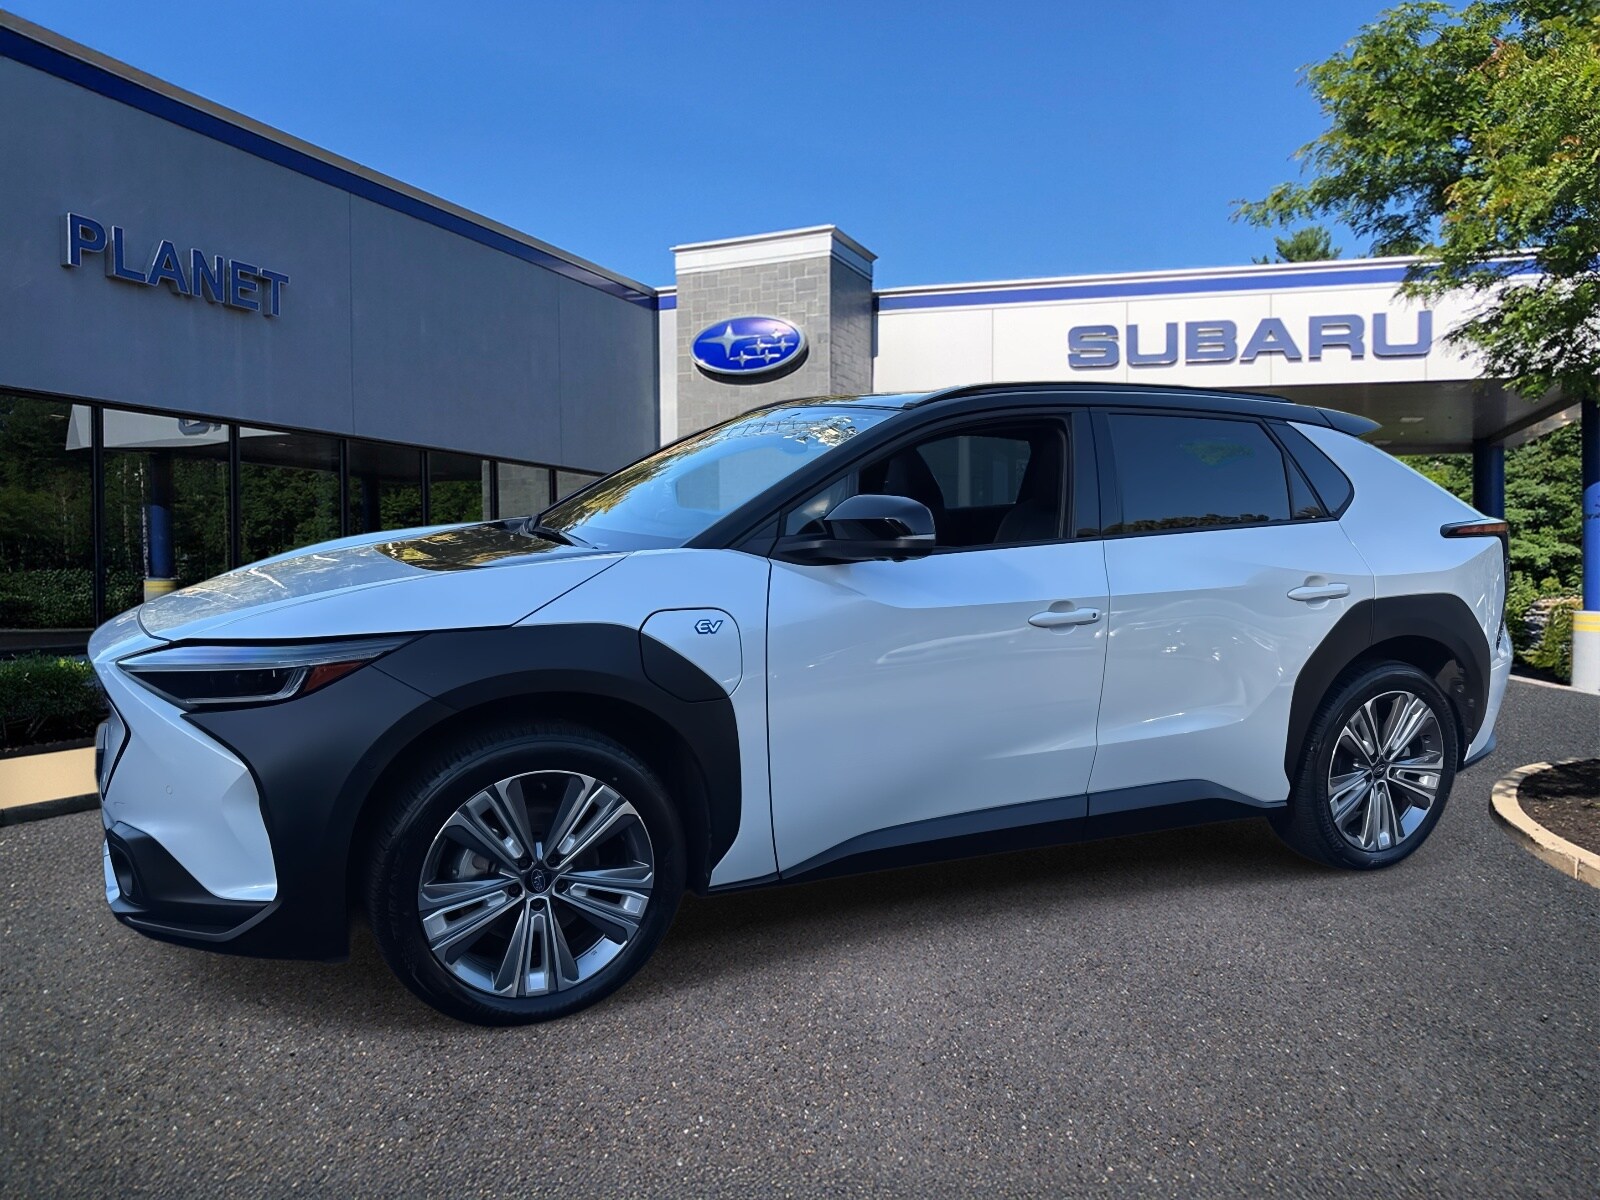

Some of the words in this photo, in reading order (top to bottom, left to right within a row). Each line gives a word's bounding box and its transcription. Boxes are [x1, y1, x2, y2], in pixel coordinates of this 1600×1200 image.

[64, 212, 289, 316] PLANET
[1068, 311, 1432, 368] SUBARU
[694, 619, 723, 634] EV
